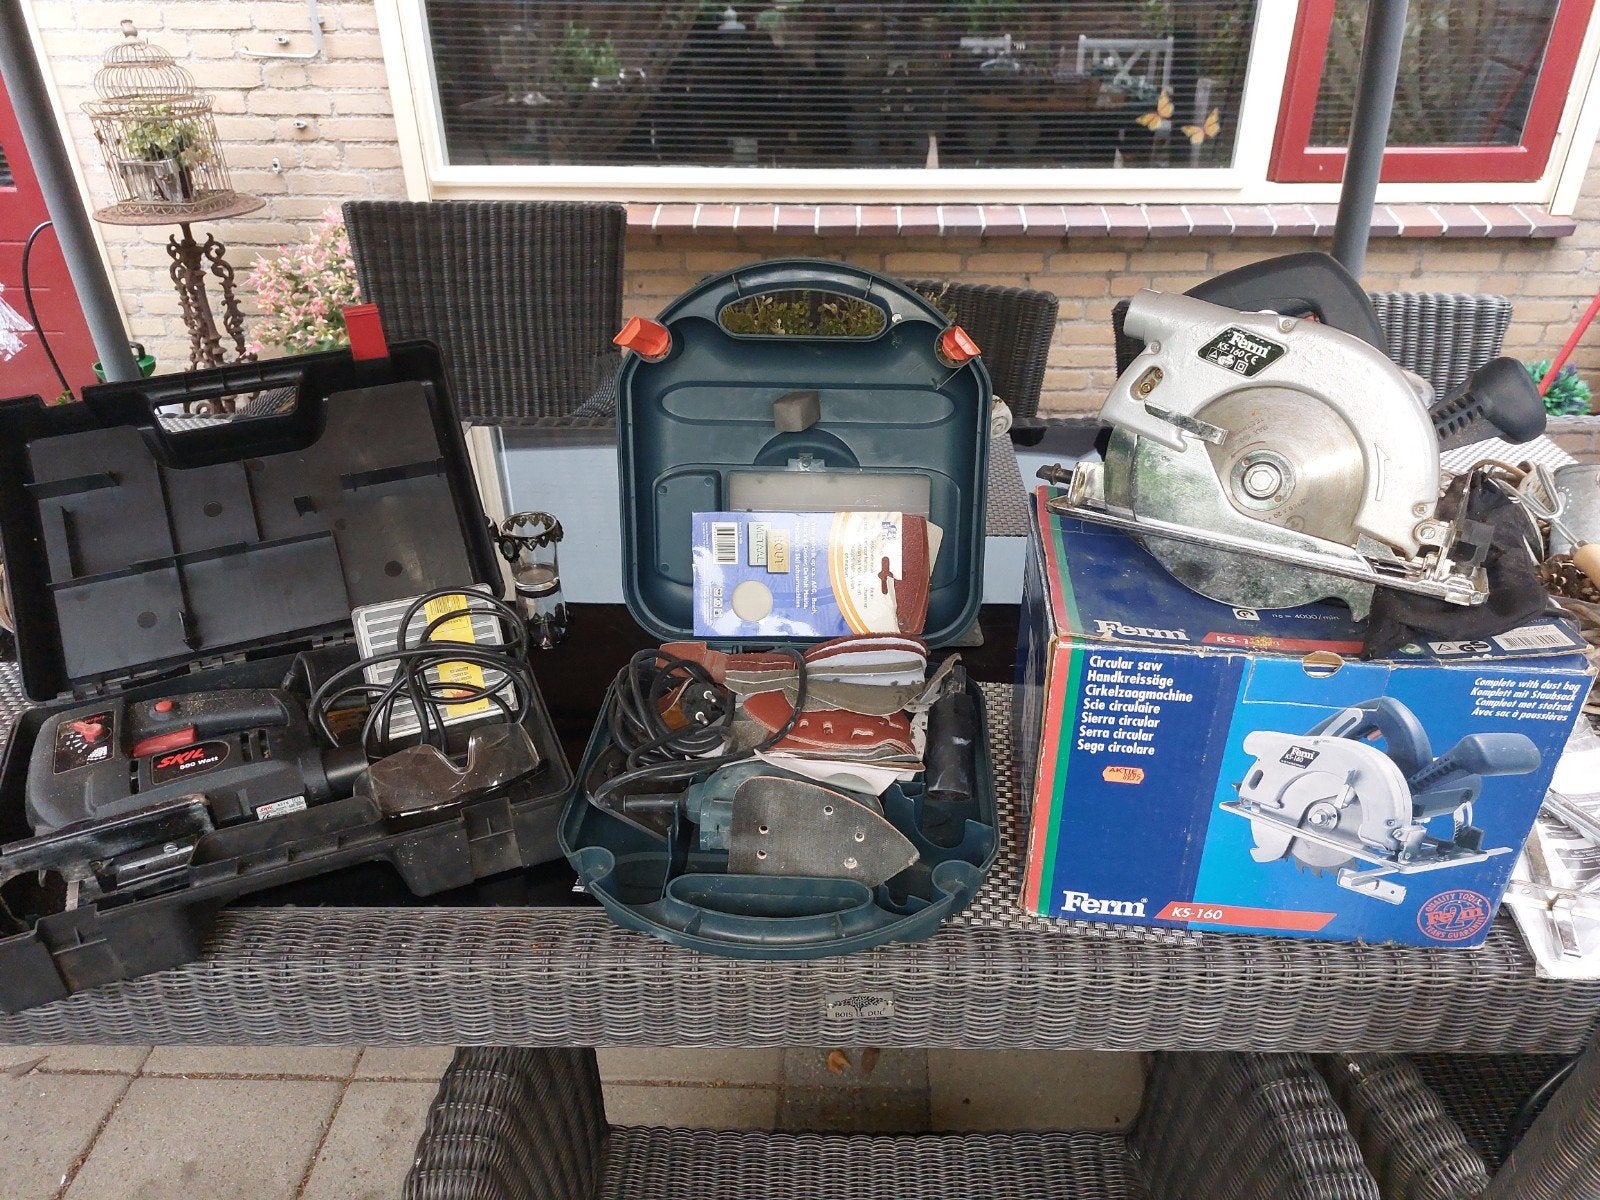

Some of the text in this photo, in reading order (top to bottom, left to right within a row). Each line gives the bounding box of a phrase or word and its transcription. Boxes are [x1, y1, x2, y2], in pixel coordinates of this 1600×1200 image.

[1217, 341, 1245, 358] KS-160
[1229, 331, 1269, 358] Ferm
[756, 524, 765, 564] METAAL
[1094, 620, 1190, 641] Ferm
[1089, 655, 1163, 672] Circular saw
[1087, 670, 1174, 687] Handkreissäge
[1474, 677, 1581, 693] Complete with dust bag
[1085, 684, 1193, 703] Cirkelzaagmachine
[1470, 687, 1577, 701] Komplett mit Staubsack
[1083, 698, 1160, 714] Scie circulaire
[1475, 697, 1573, 712] Compleet met stofzak
[1081, 712, 1160, 728] Sierra circular
[1471, 707, 1494, 716] Avec
[1512, 709, 1519, 718] à
[1518, 711, 1568, 721] poussières
[1079, 725, 1154, 742] Serra circular
[1077, 739, 1155, 756] Sega circolare
[1291, 747, 1315, 760] Ferm
[157, 747, 204, 769] SKIL
[198, 756, 218, 765] Watt
[1061, 890, 1146, 918] Ferm
[1426, 894, 1456, 912] QUALITY
[1171, 906, 1223, 920] KS-160
